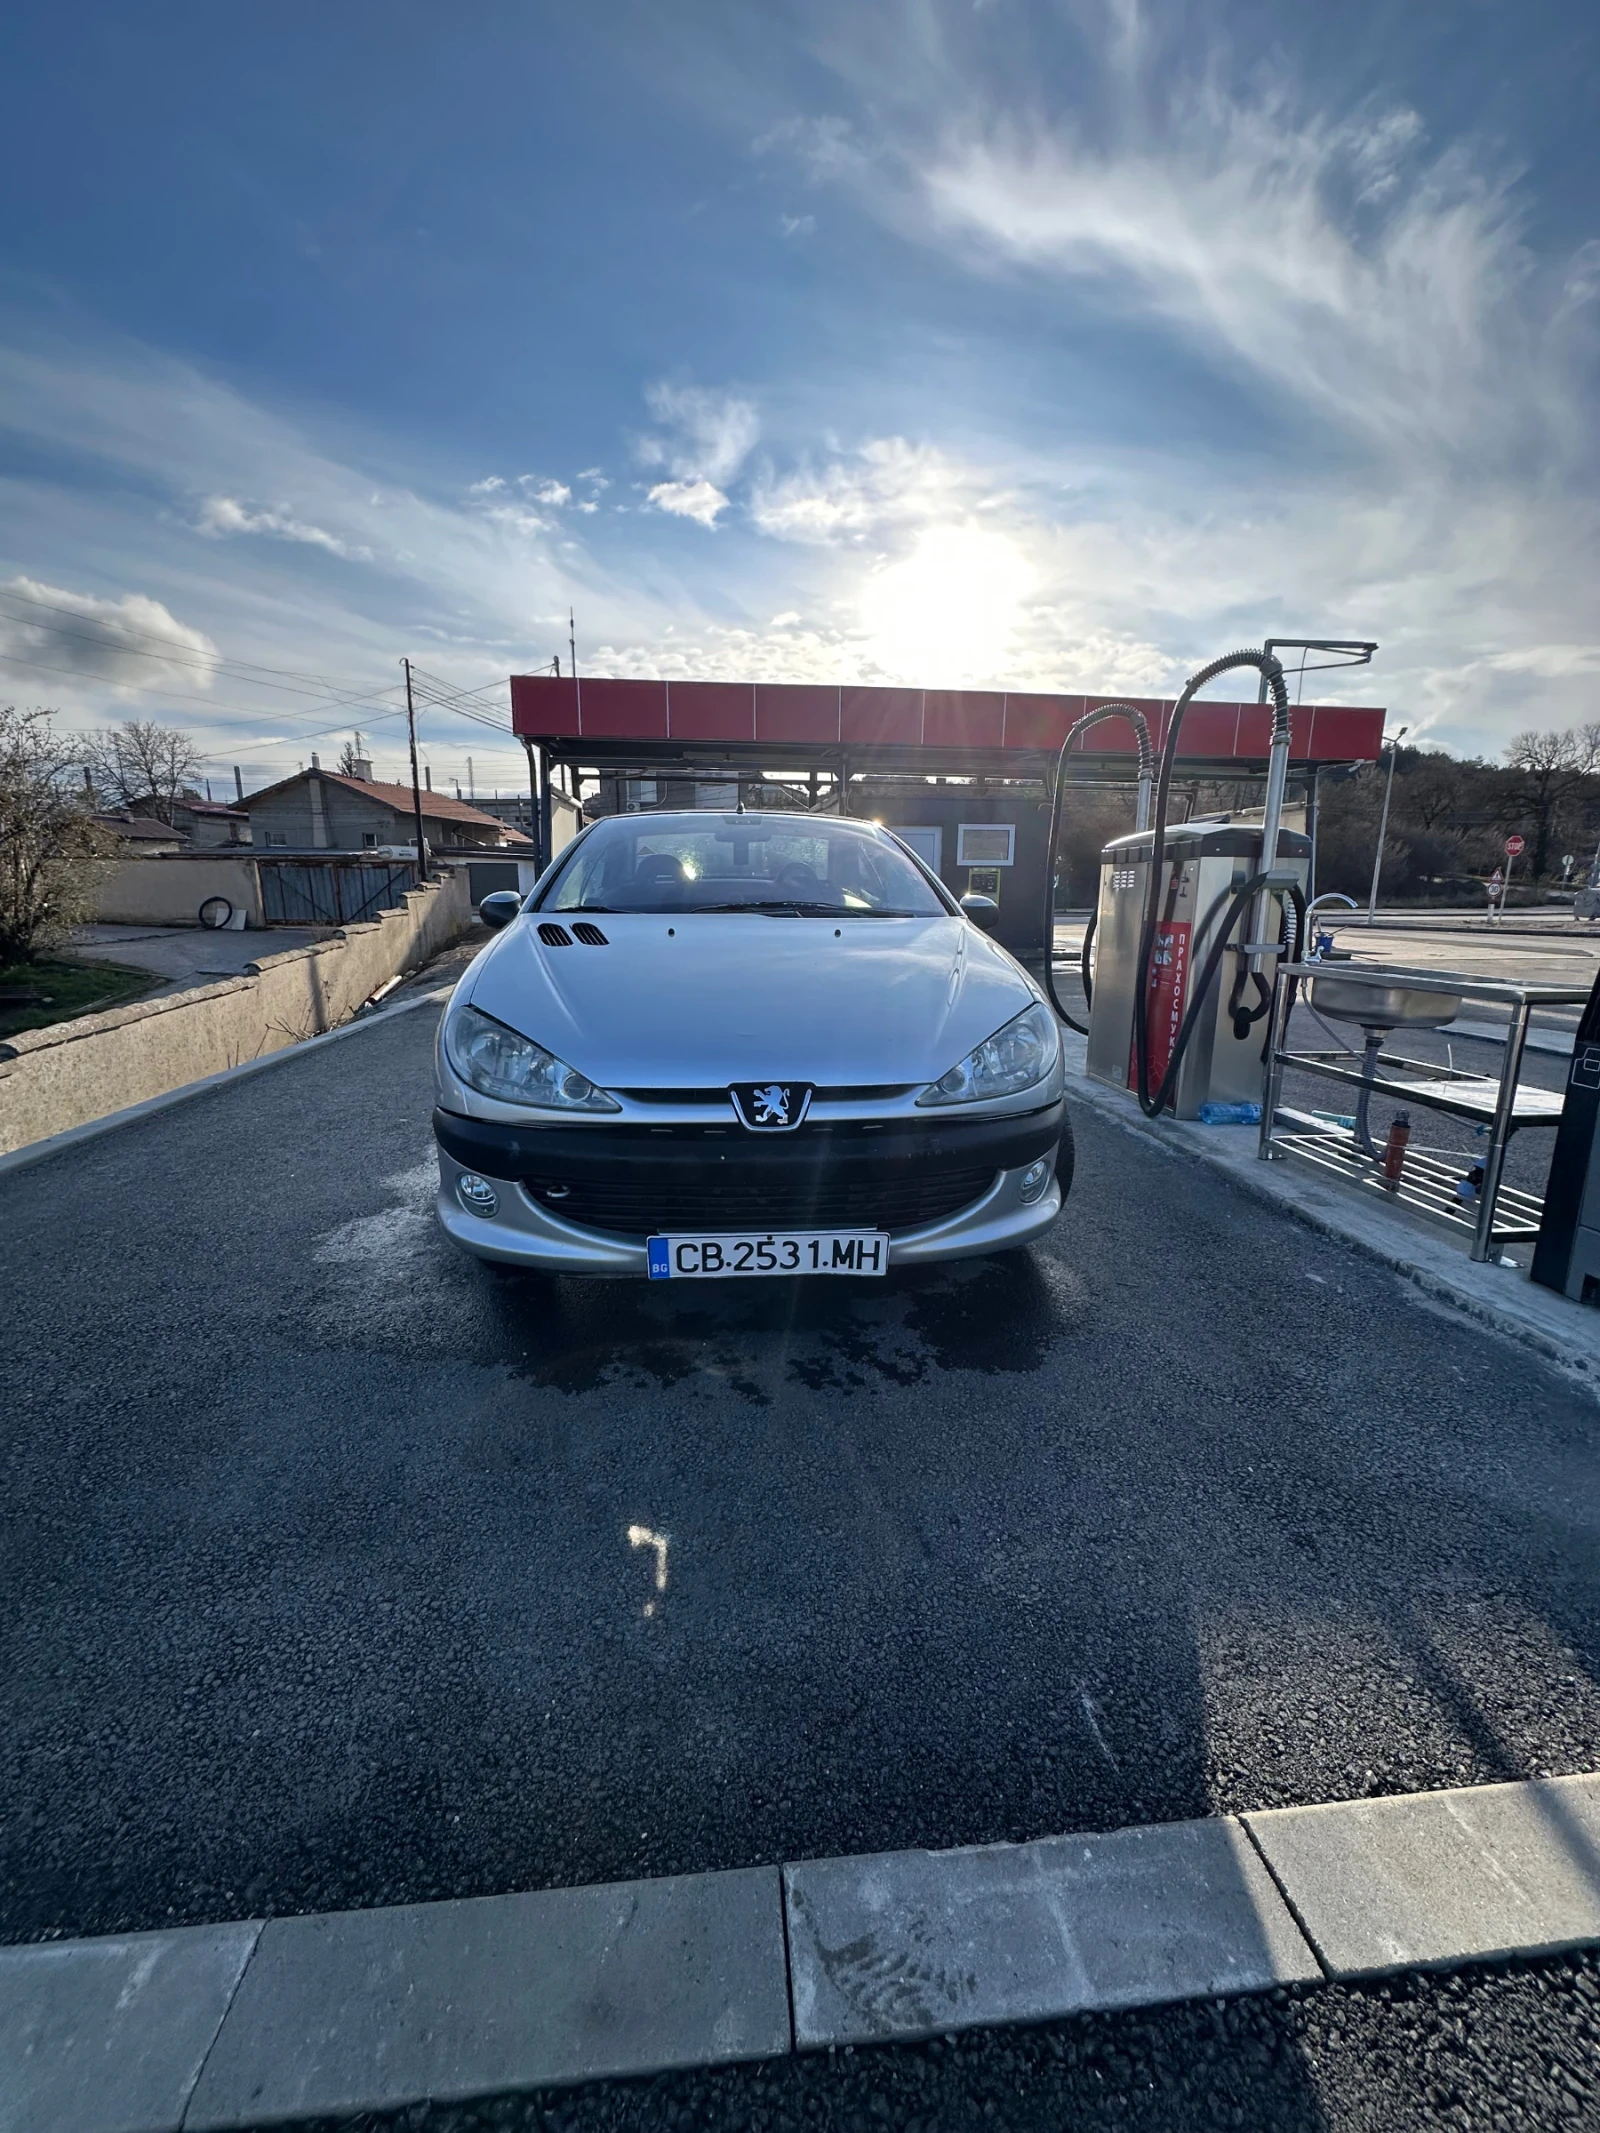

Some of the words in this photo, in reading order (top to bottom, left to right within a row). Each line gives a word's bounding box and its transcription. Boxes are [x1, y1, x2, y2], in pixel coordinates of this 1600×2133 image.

[1507, 842, 1523, 851] STOP
[1167, 933, 1186, 1066] ПРАХОСМУКА
[652, 1263, 668, 1273] BG
